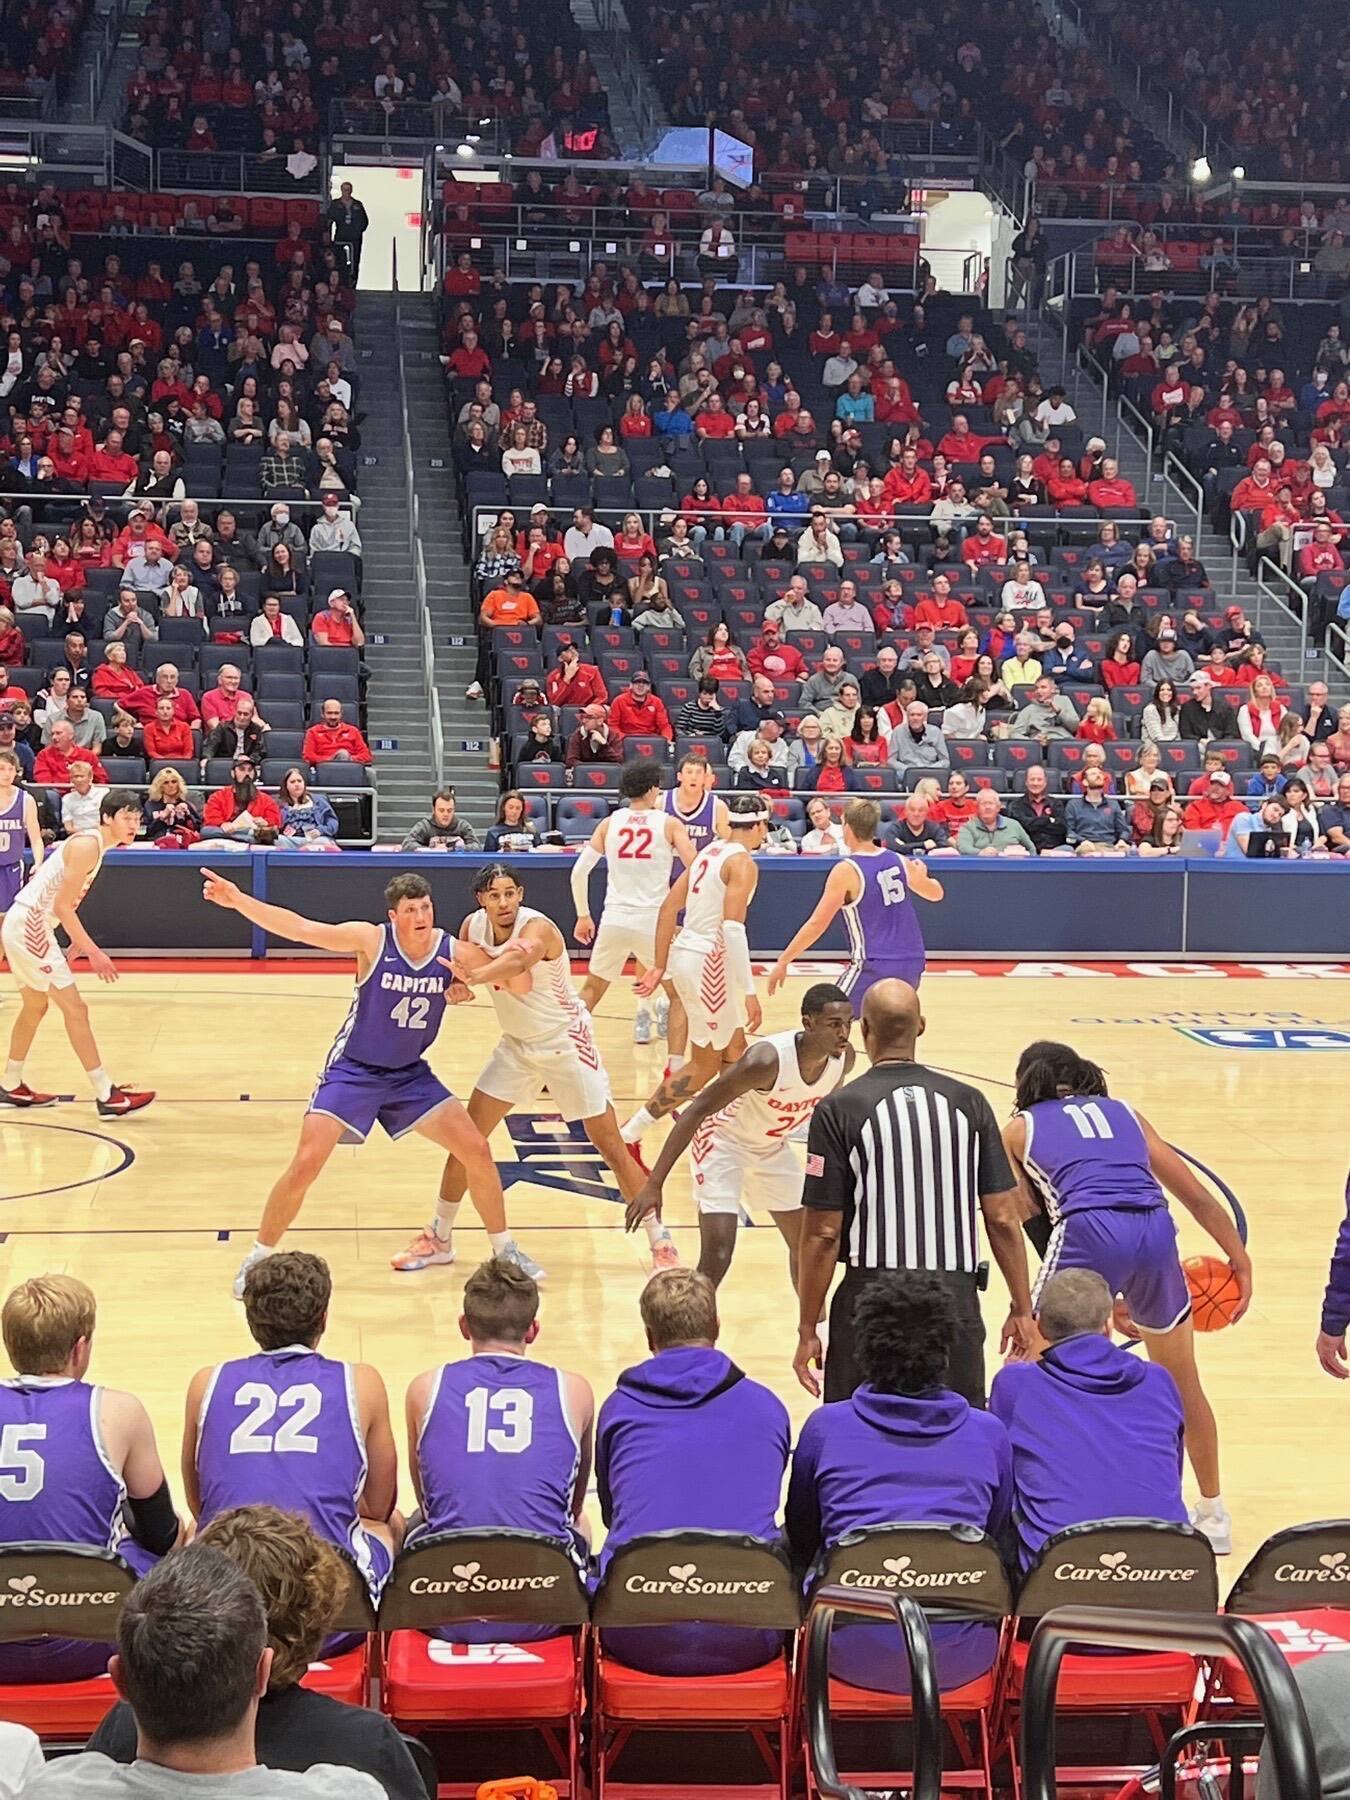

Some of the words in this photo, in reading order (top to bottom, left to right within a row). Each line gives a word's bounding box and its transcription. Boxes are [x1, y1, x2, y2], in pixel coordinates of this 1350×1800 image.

[466, 741, 480, 751] 112
[617, 827, 653, 860] 22
[691, 859, 710, 894] 2
[877, 866, 906, 906] 15
[380, 972, 444, 994] CAPITAL
[390, 996, 431, 1029] 42
[1062, 1102, 1114, 1139] 11
[229, 1381, 323, 1455] 22
[464, 1386, 534, 1454] 13
[409, 1574, 559, 1595] CareSource
[624, 1574, 774, 1595] CareSource
[839, 1569, 986, 1588] CareSource
[1054, 1563, 1197, 1582] CareSource
